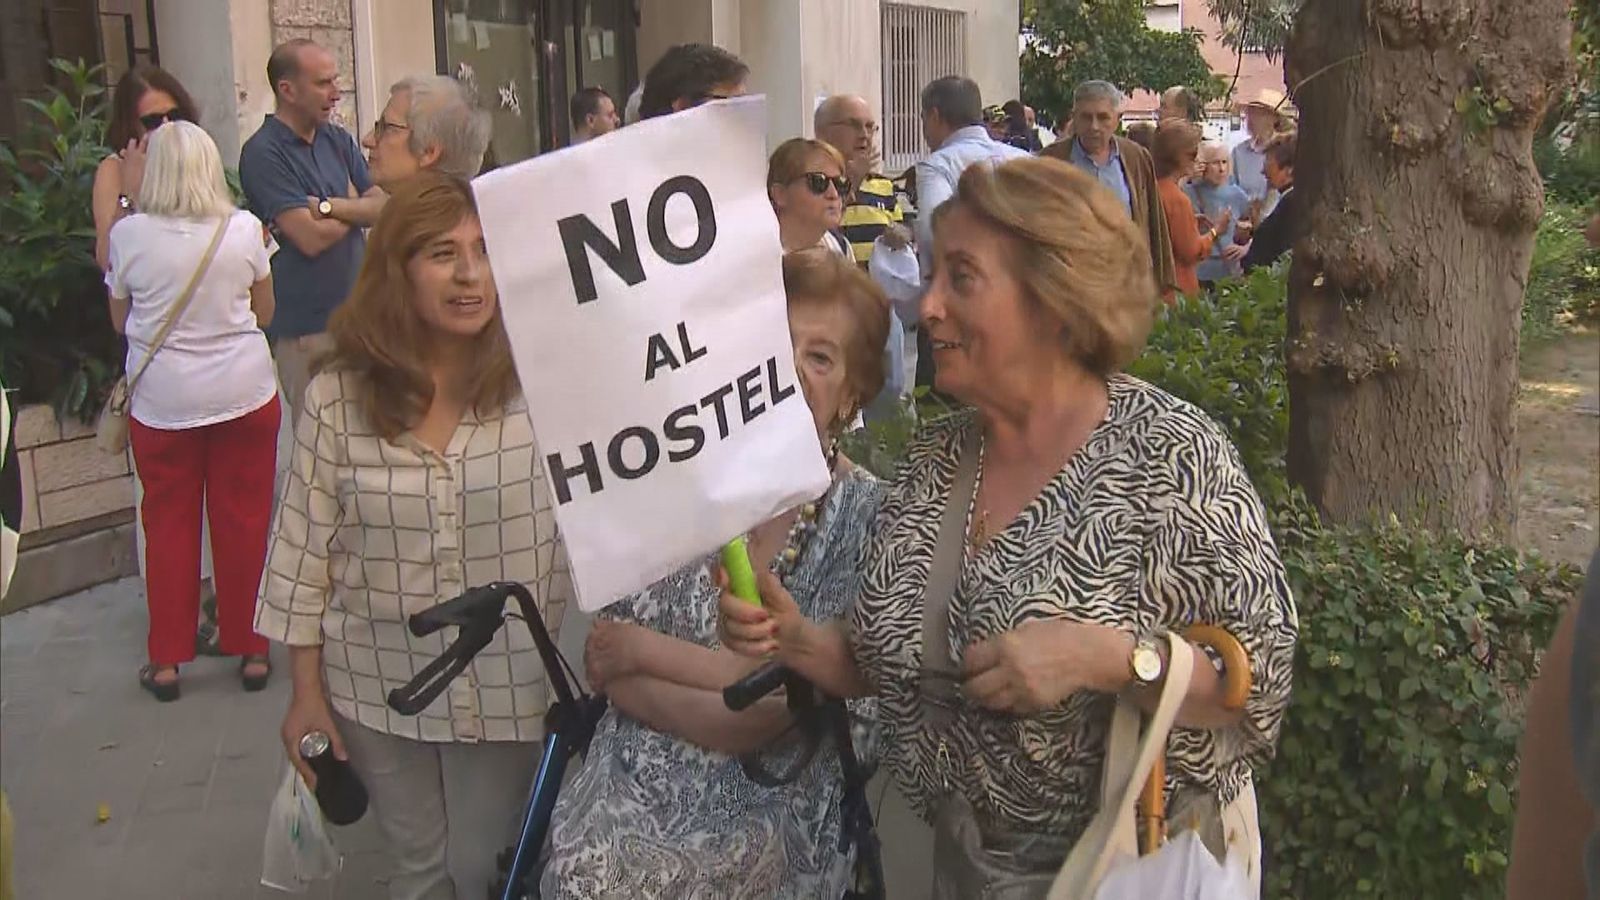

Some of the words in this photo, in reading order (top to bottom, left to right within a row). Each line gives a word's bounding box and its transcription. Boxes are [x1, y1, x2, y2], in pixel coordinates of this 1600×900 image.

[556, 174, 718, 304] NO
[644, 321, 708, 382] AL
[548, 356, 797, 505] HOSTEL
